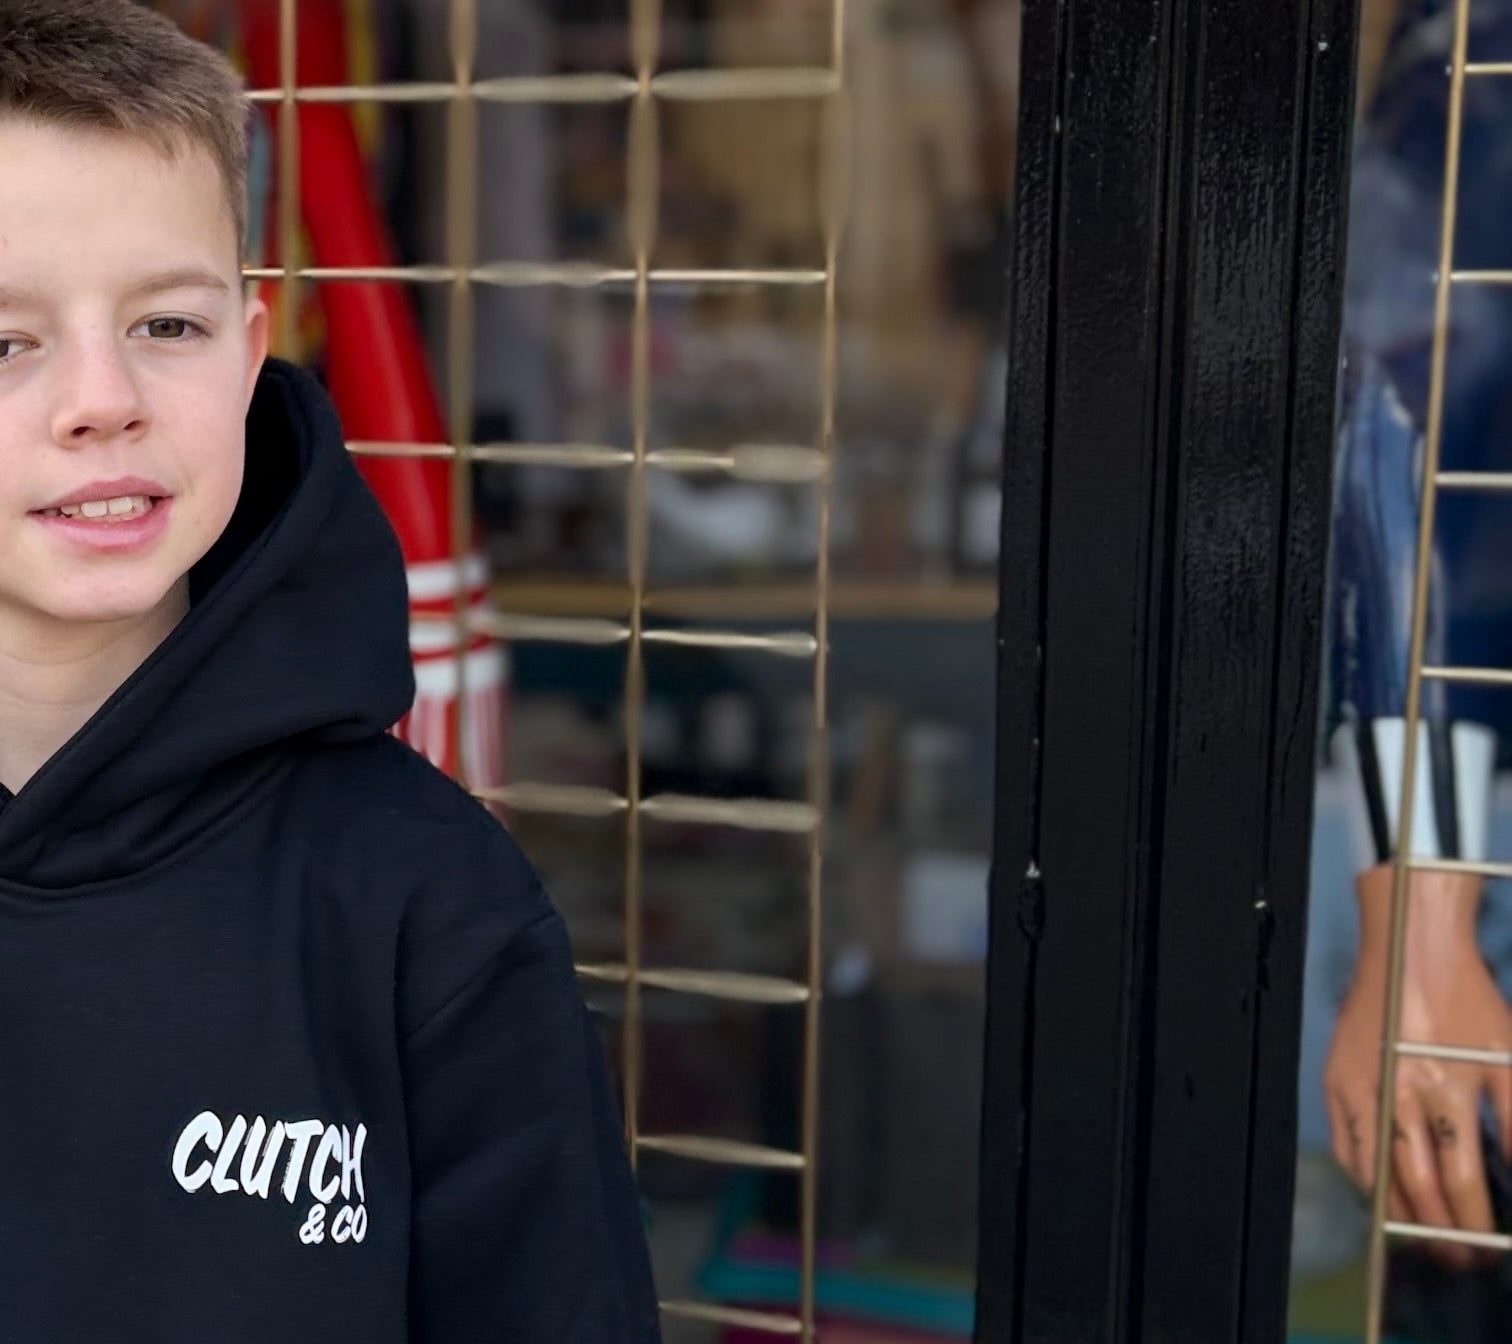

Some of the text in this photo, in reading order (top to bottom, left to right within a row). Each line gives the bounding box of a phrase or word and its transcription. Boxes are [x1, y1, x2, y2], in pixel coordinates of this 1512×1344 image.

[172, 1111, 367, 1204] CLUTCH
[299, 1203, 368, 1244] & CO
